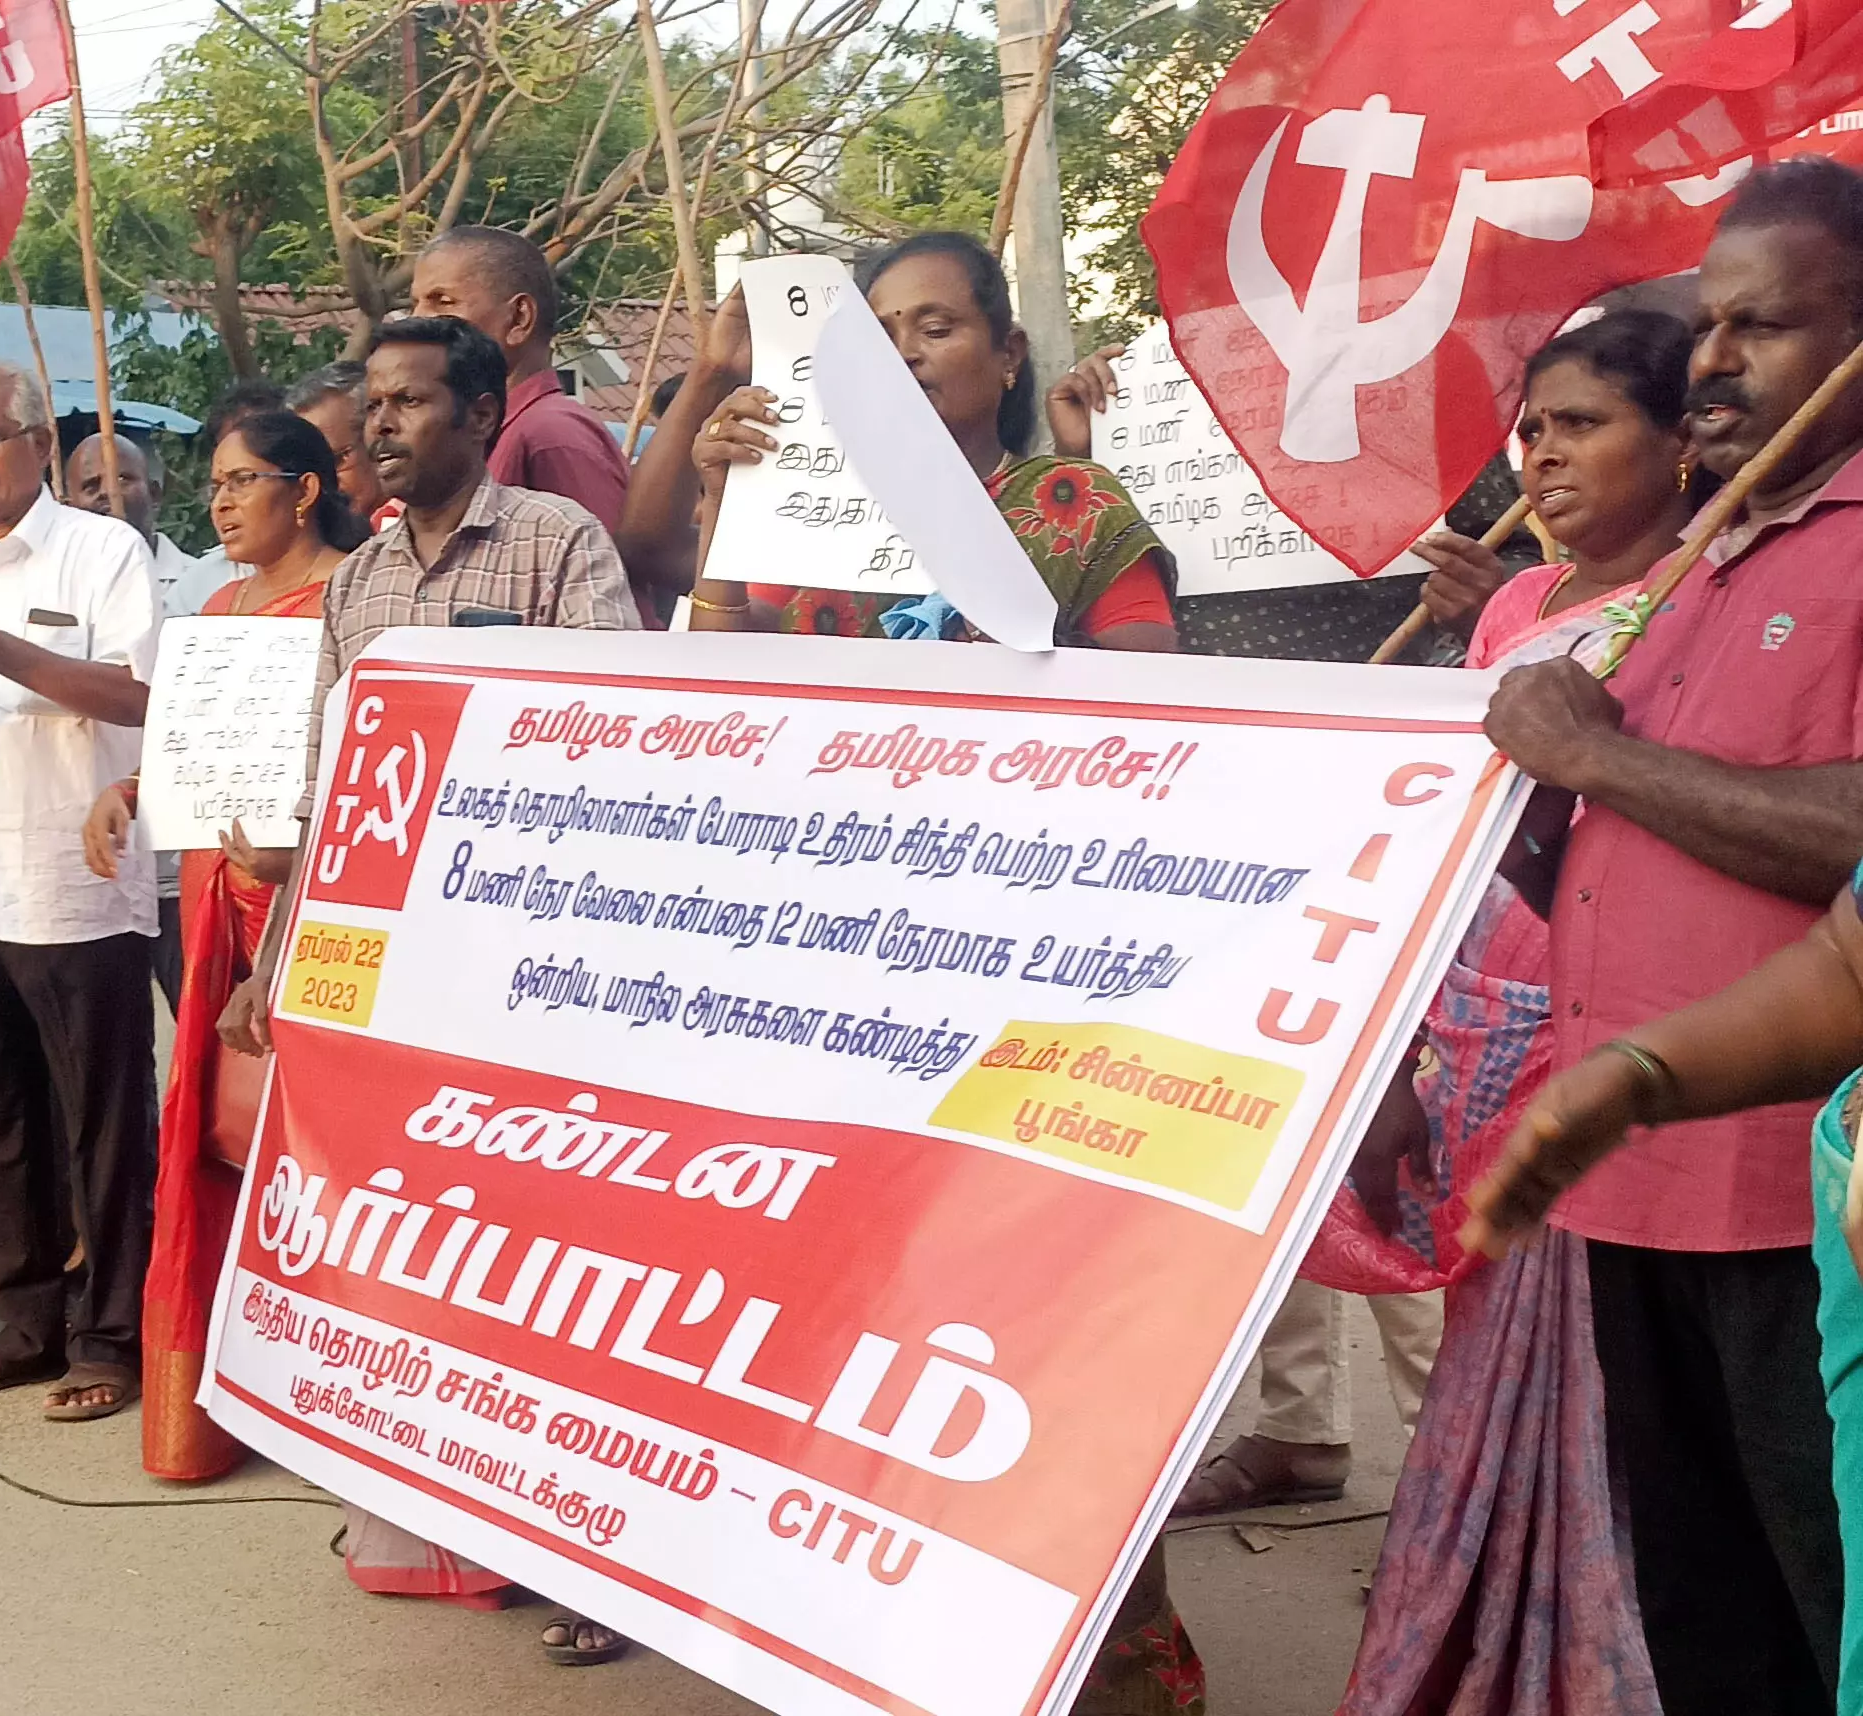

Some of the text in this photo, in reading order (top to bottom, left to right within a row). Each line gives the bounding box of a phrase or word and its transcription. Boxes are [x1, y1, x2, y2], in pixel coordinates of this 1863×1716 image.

[787, 285, 809, 316] 8
[1115, 387, 1132, 408] 8
[1118, 348, 1136, 371] 8
[778, 396, 806, 423] 8
[1111, 427, 1127, 449] 8
[775, 443, 845, 478] இது
[318, 695, 385, 883] CITU
[503, 699, 1199, 800] தமிழக அரசே! தமிழக அரசே!!
[437, 778, 1311, 905] உலகத் தொழிலாளர்கள் போராடி உதிரம் சிந்தி பெற்ற உரிமையான
[297, 929, 384, 969] ஏப்ரல் 22
[442, 839, 1193, 1004] 8 மணி நேர வேலை என்பதை 12 மணி நேரமாக உயர்த்திய
[1257, 762, 1454, 1045] CITU
[301, 978, 358, 1013] 2023
[506, 952, 979, 1082] ஒன்றிய, மாநில அரசுகளை கண்டித்து
[979, 1036, 1280, 1133] இடம்: சின்னப்பா
[1011, 1095, 1150, 1160] பூங்கா
[405, 1083, 838, 1222] கண்டன
[257, 1153, 1033, 1484] ஆர்ப்பாட்டம்
[242, 1281, 309, 1346] இந்திய
[309, 1316, 432, 1398] தொழிற்
[436, 1368, 541, 1435] சங்க
[545, 1411, 718, 1501] மையம்
[768, 1488, 924, 1586] CITU
[290, 1374, 626, 1547] புதுக்கோட்டை மாவட்டக்குழு
